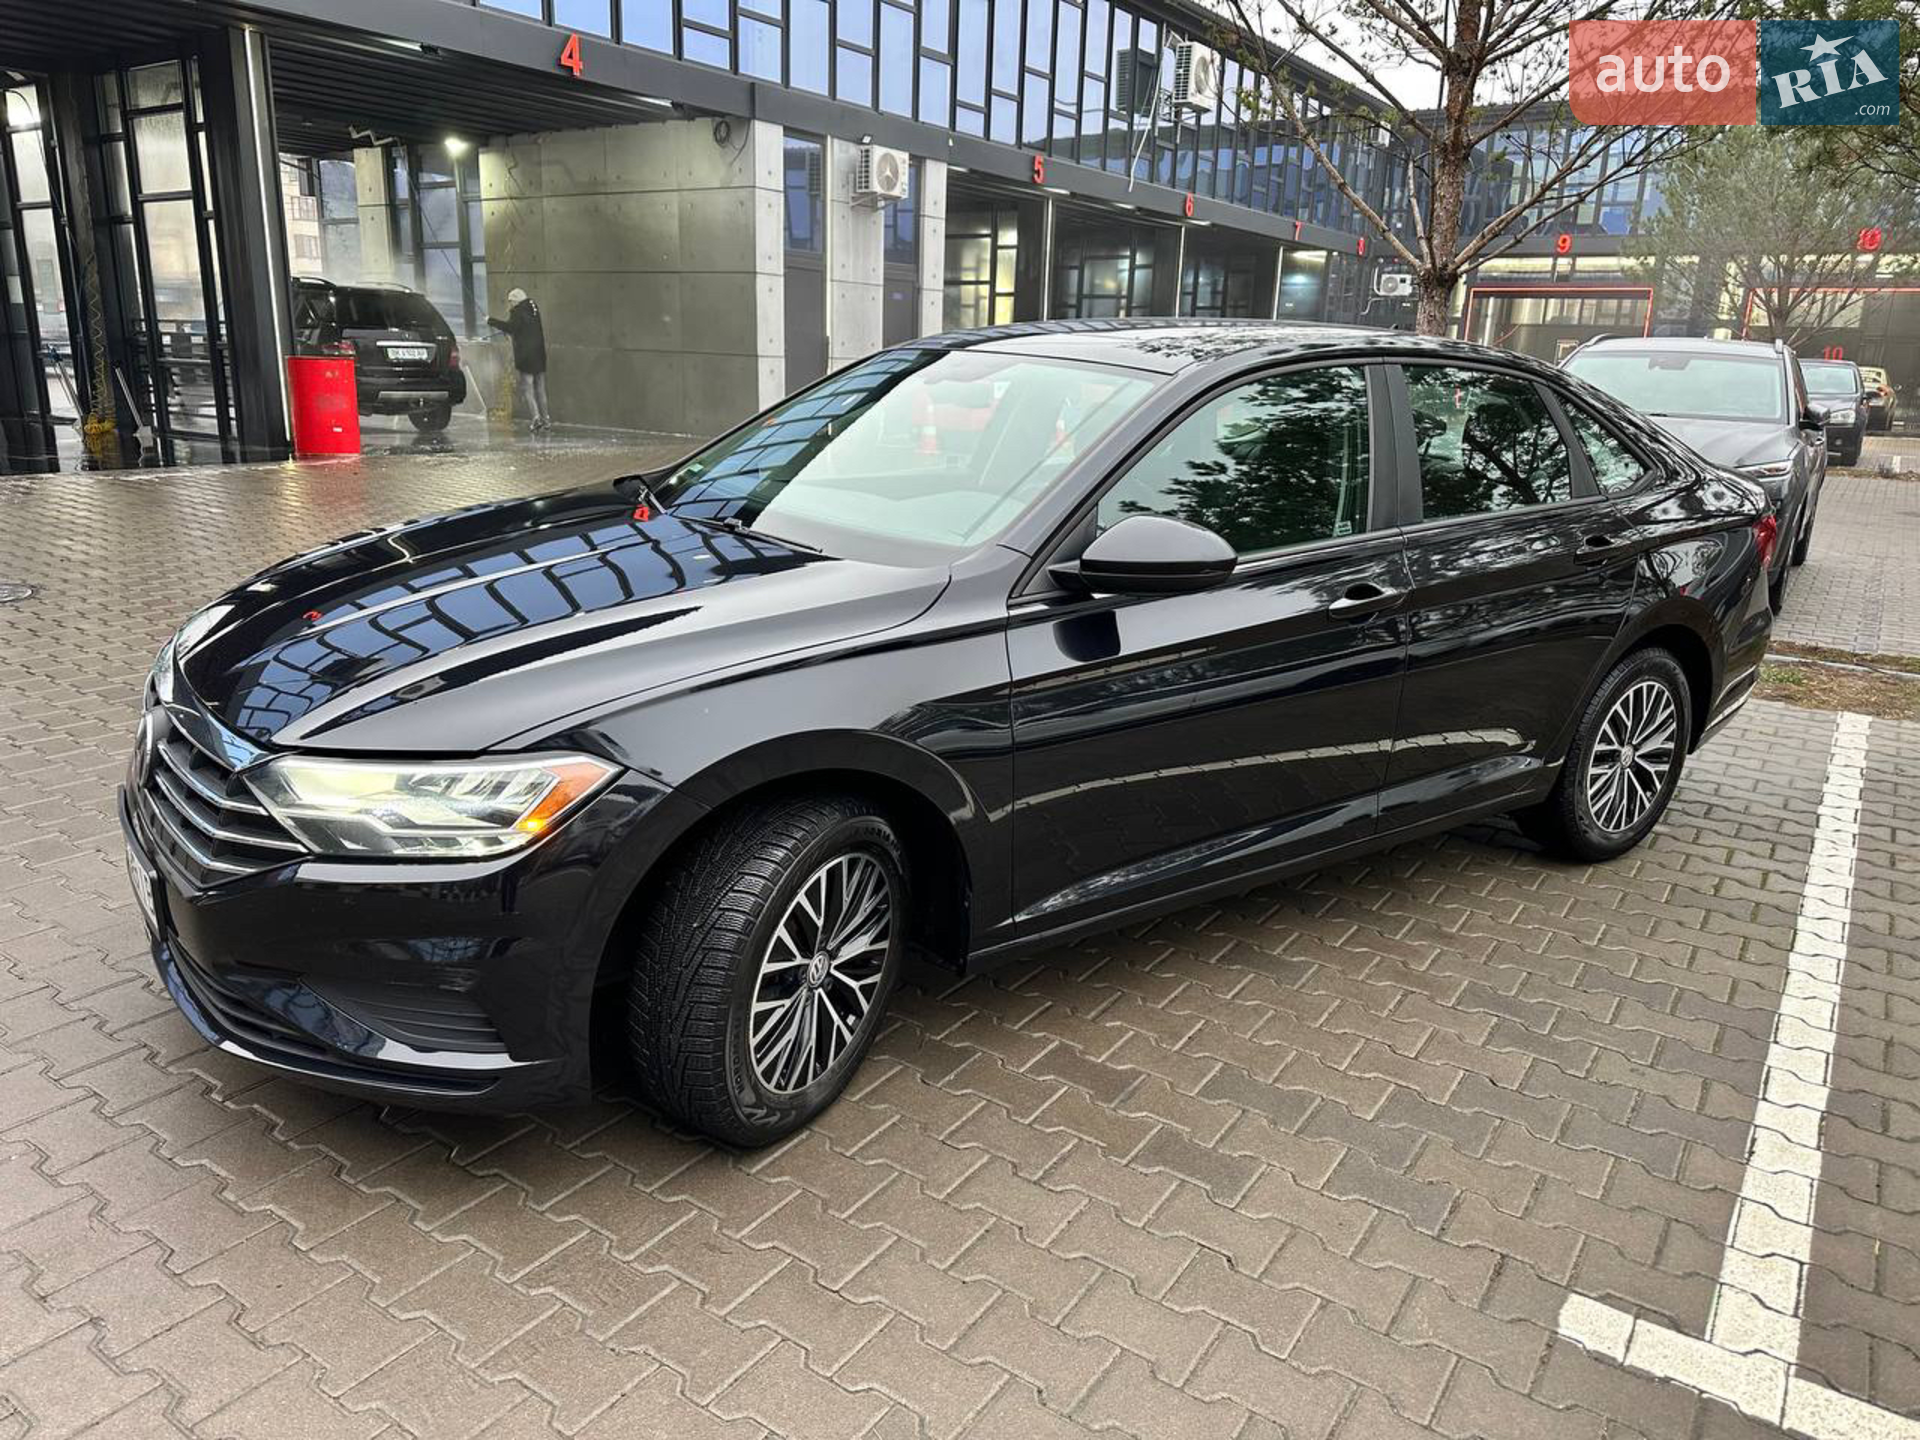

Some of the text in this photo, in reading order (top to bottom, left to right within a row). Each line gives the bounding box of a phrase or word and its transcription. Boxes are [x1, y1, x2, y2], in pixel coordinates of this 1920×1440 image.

[560, 33, 583, 77] 4
[1034, 154, 1045, 184] 5
[1185, 193, 1194, 217] 6
[1294, 220, 1305, 241] 7
[1557, 233, 1572, 254] 9
